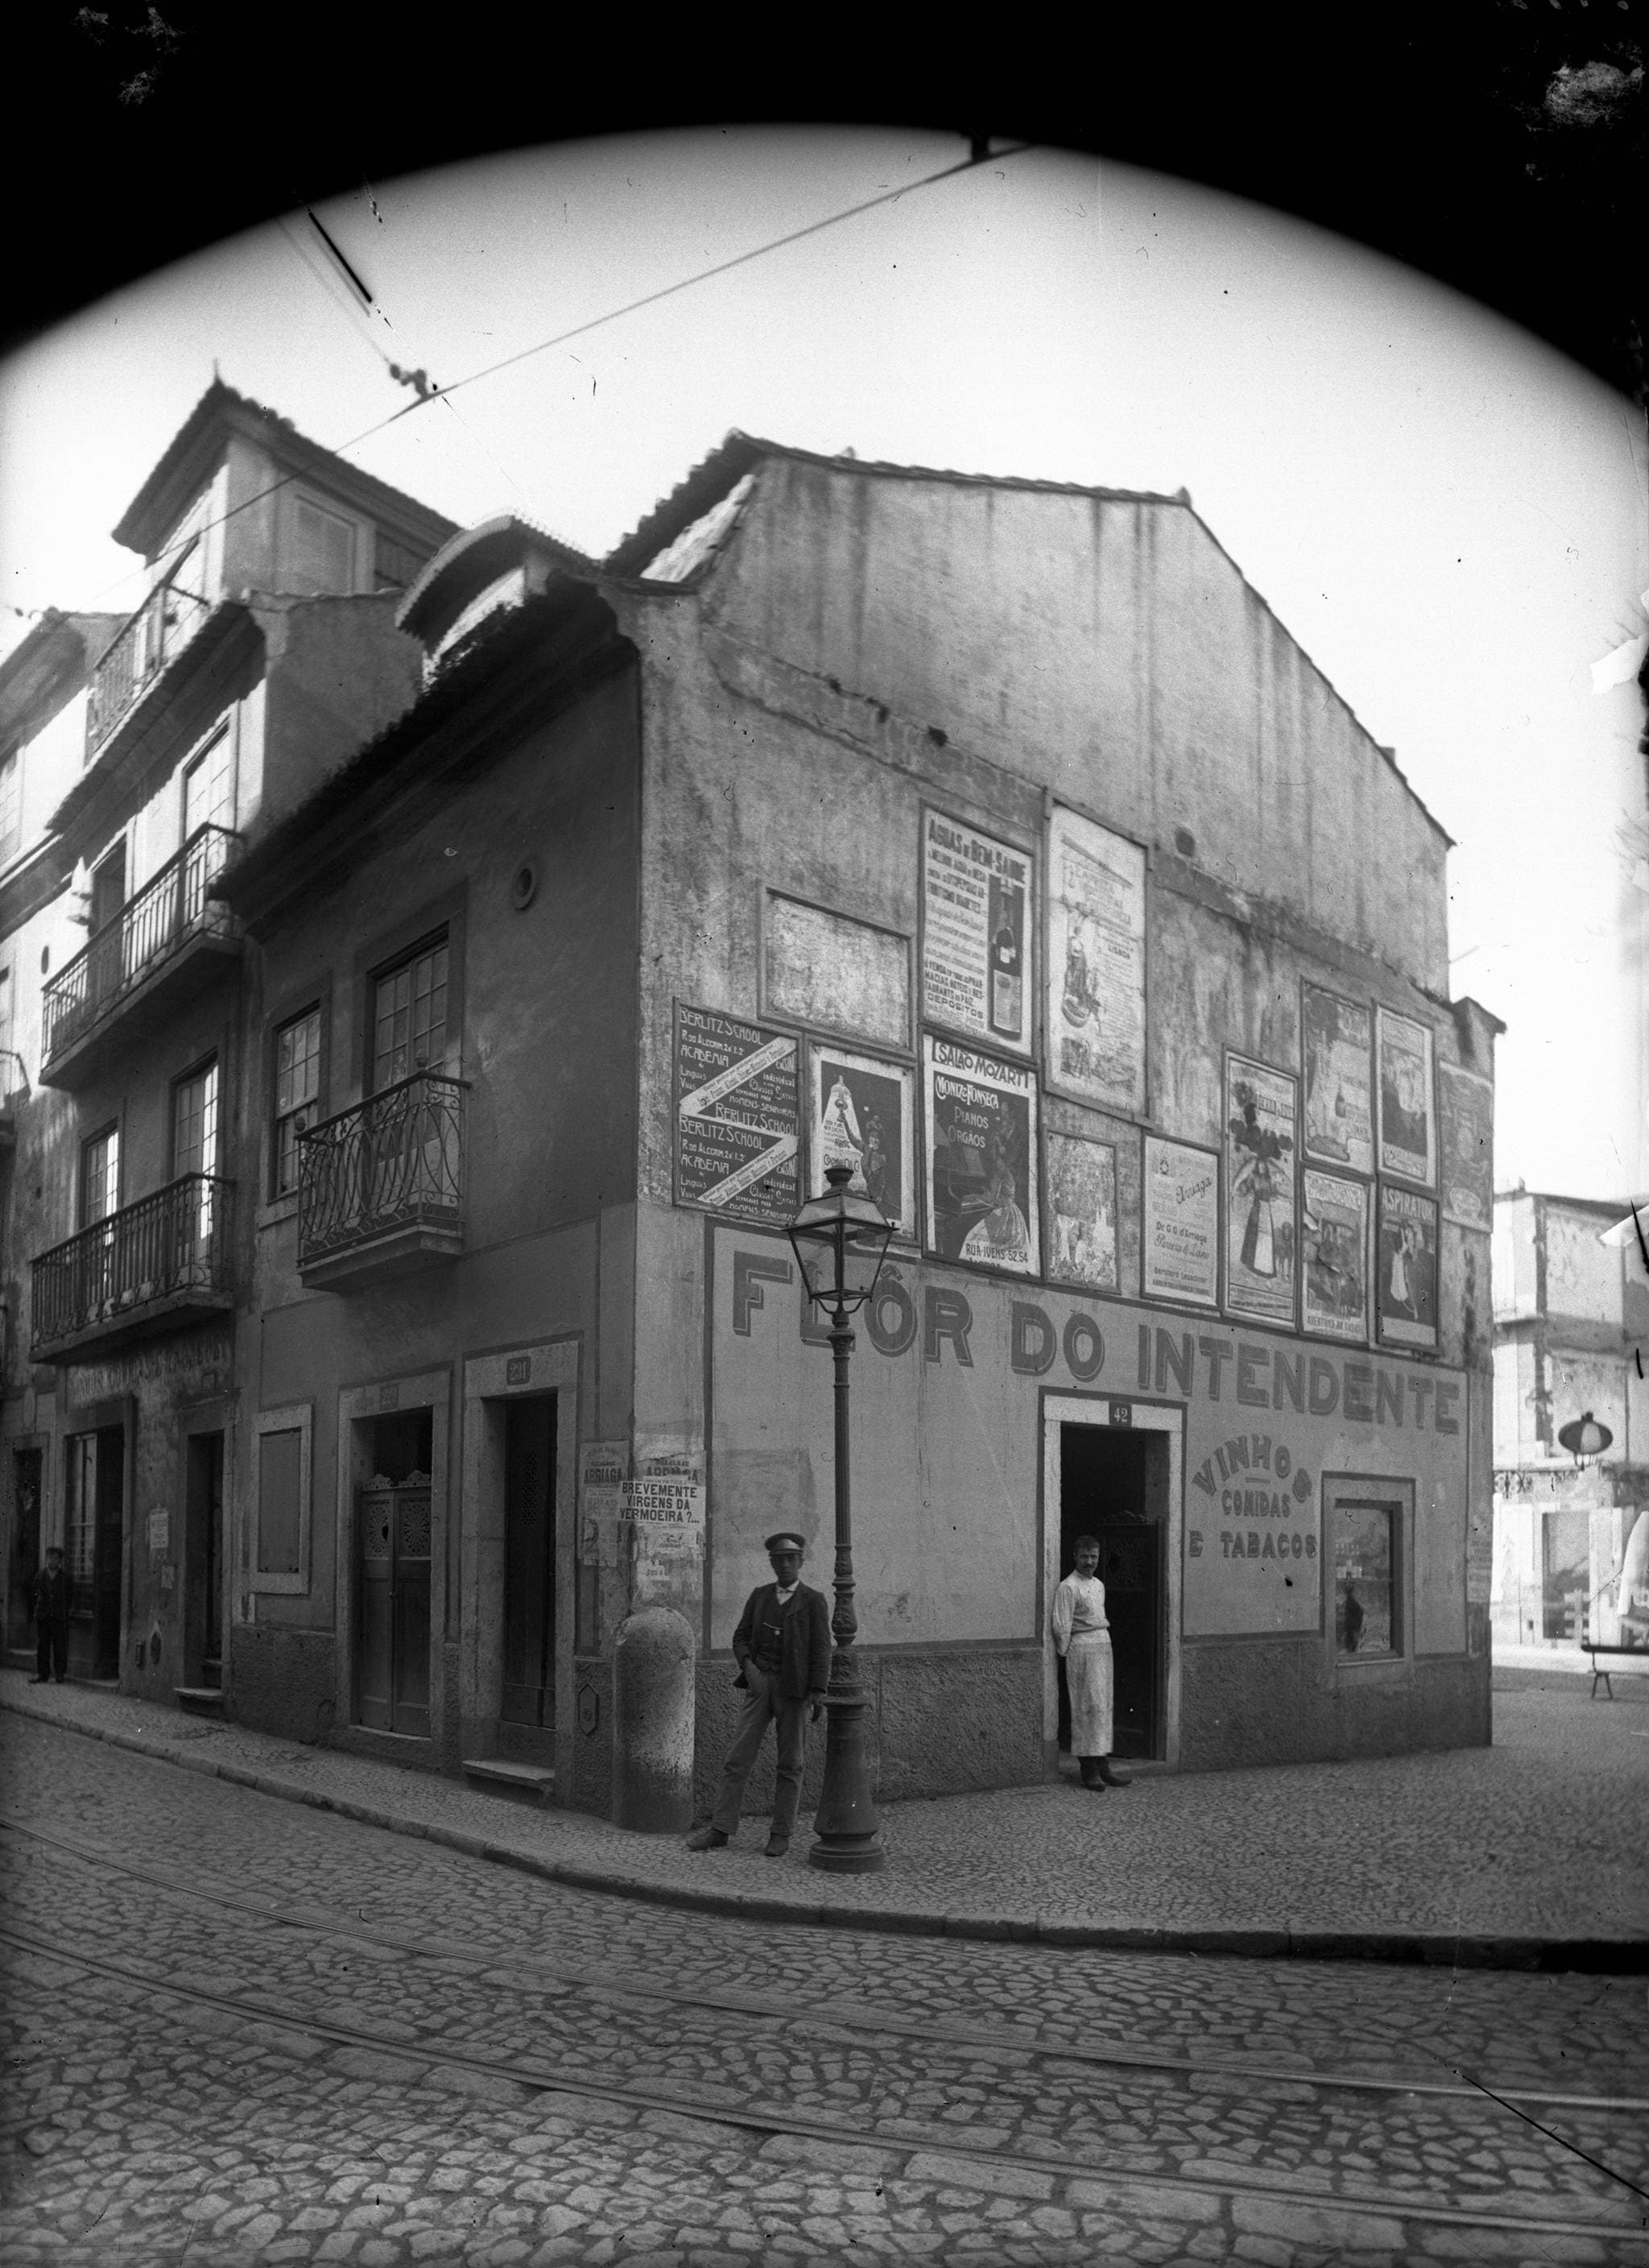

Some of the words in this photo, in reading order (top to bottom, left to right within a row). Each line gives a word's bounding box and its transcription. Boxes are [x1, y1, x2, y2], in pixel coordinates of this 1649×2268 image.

[680, 1007, 724, 1034] BERLITZ
[725, 1020, 764, 1045] SCHOOL
[680, 1045, 729, 1068] ACADEMIA
[715, 1102, 758, 1128] BERLITZ
[760, 1113, 796, 1136] SCHOOL
[954, 1106, 989, 1129] PIANOS
[679, 1114, 725, 1141] BERLITZ
[726, 1126, 765, 1151] SCHOOL
[680, 1153, 729, 1175] ACADEMIA
[1010, 1300, 1106, 1383] DO
[1137, 1324, 1460, 1435] INTENDENTE
[1114, 1407, 1128, 1422] 42
[584, 1467, 622, 1484] ARRIAGA
[622, 1482, 698, 1498] BREVEMENTE
[620, 1507, 684, 1523] VERMOEIRA
[626, 1496, 673, 1509] VIRGENS
[676, 1497, 690, 1511] DA
[1221, 1489, 1291, 1518] COMIDAS
[1188, 1530, 1204, 1558] E
[1220, 1531, 1317, 1559] TABACOS
